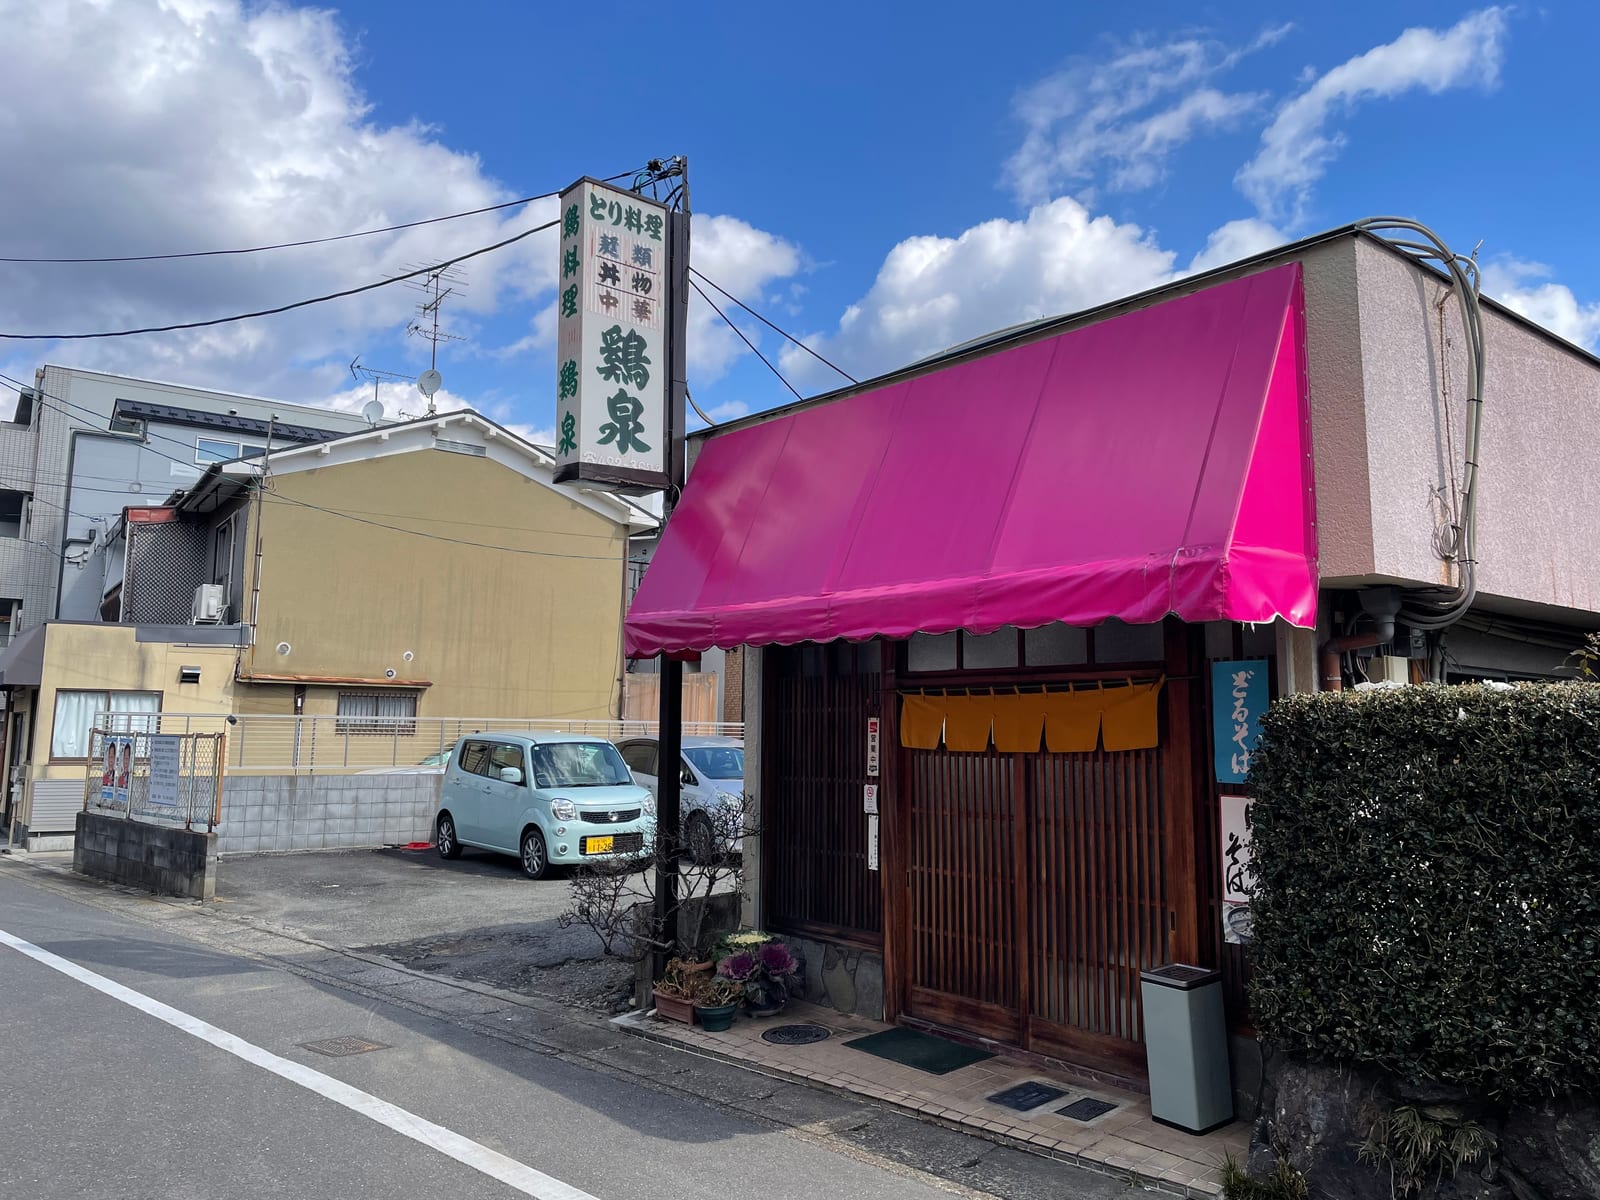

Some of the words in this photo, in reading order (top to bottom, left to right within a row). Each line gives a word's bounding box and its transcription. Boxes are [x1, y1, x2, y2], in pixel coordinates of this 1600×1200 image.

[590, 192, 664, 242] とり料理
[561, 203, 580, 318] 鶏料理
[598, 262, 652, 295] 丼物
[598, 290, 652, 322] 中華
[596, 324, 652, 455] 鶏泉
